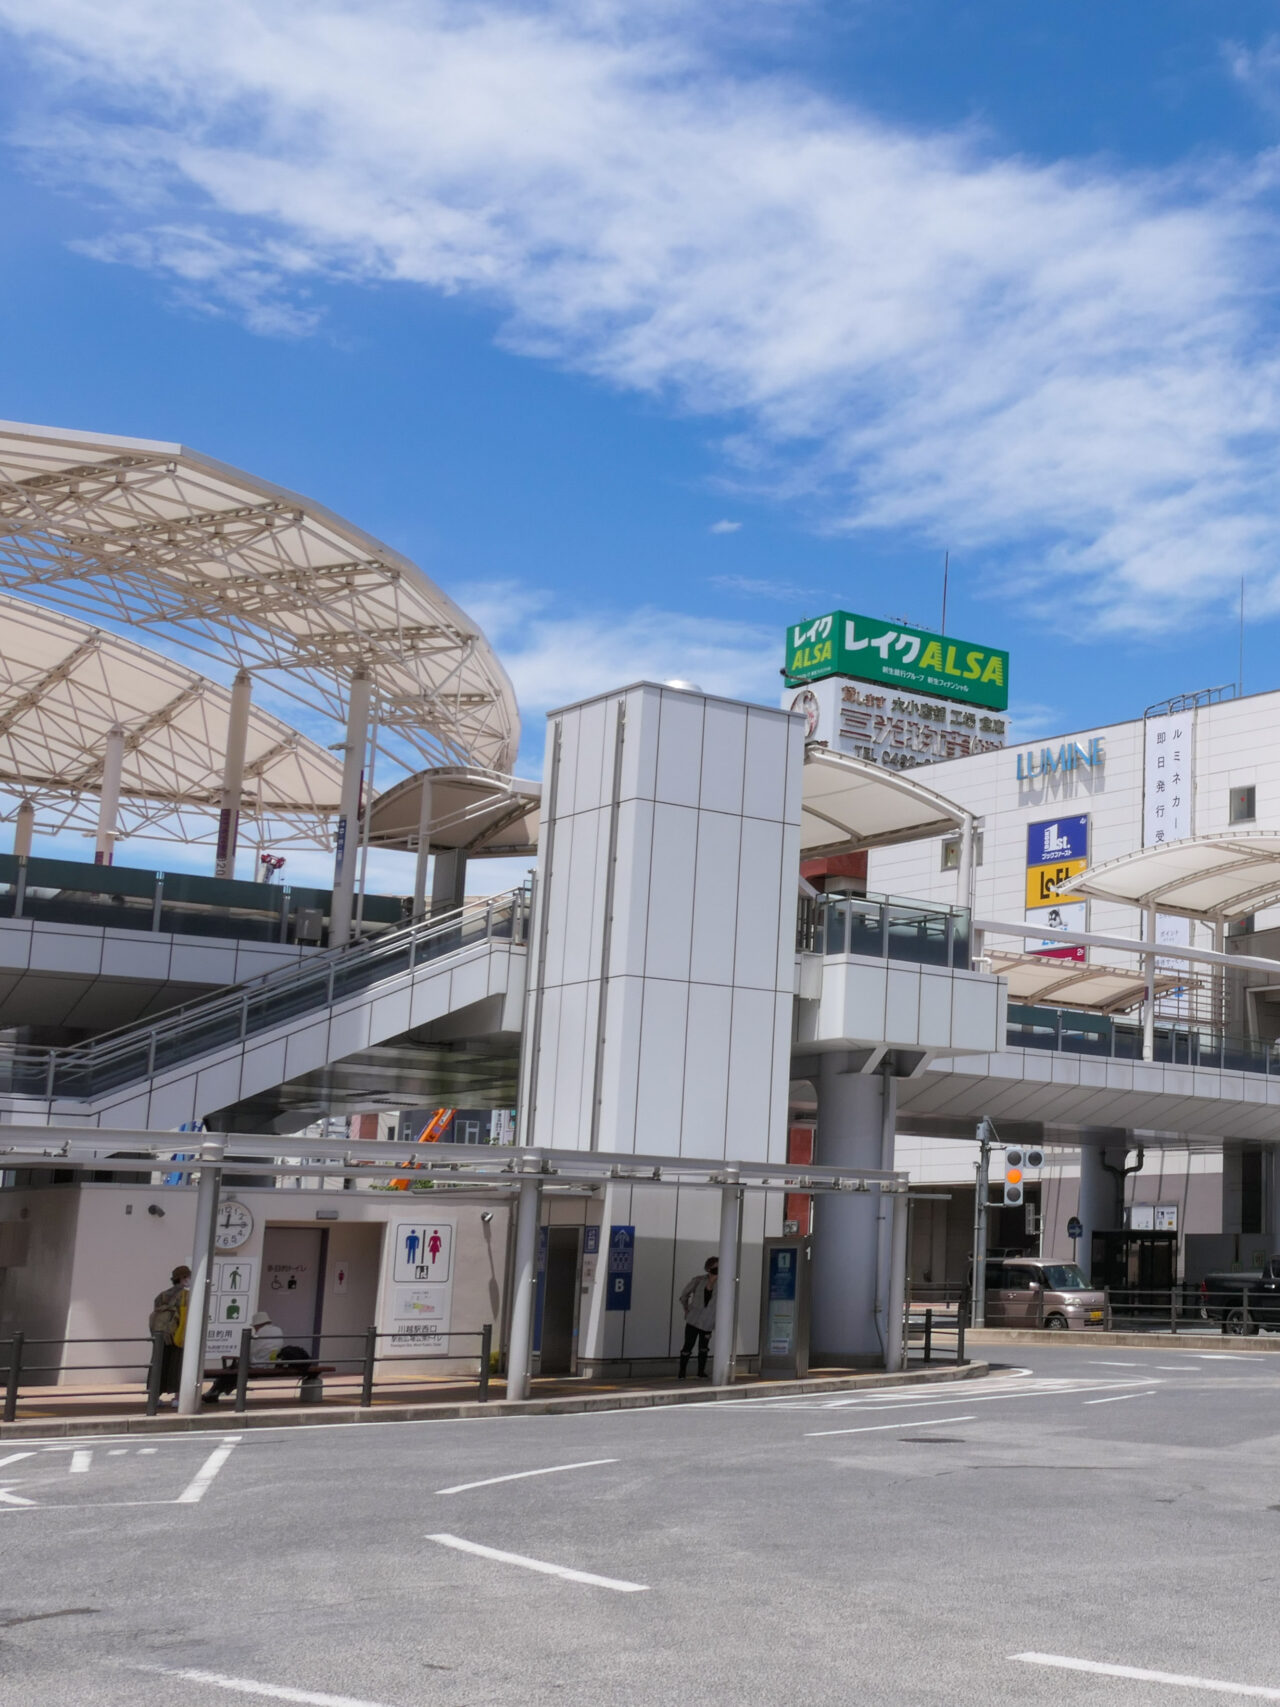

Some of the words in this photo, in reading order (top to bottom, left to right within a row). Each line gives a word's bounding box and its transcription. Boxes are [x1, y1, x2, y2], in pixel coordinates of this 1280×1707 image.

[794, 616, 833, 648] レイク
[792, 640, 832, 671] ALSA
[1017, 736, 1105, 781] LUMINE
[1172, 729, 1182, 840] ルミネカー
[806, 1246, 811, 1260] 1
[614, 1278, 624, 1292] B
